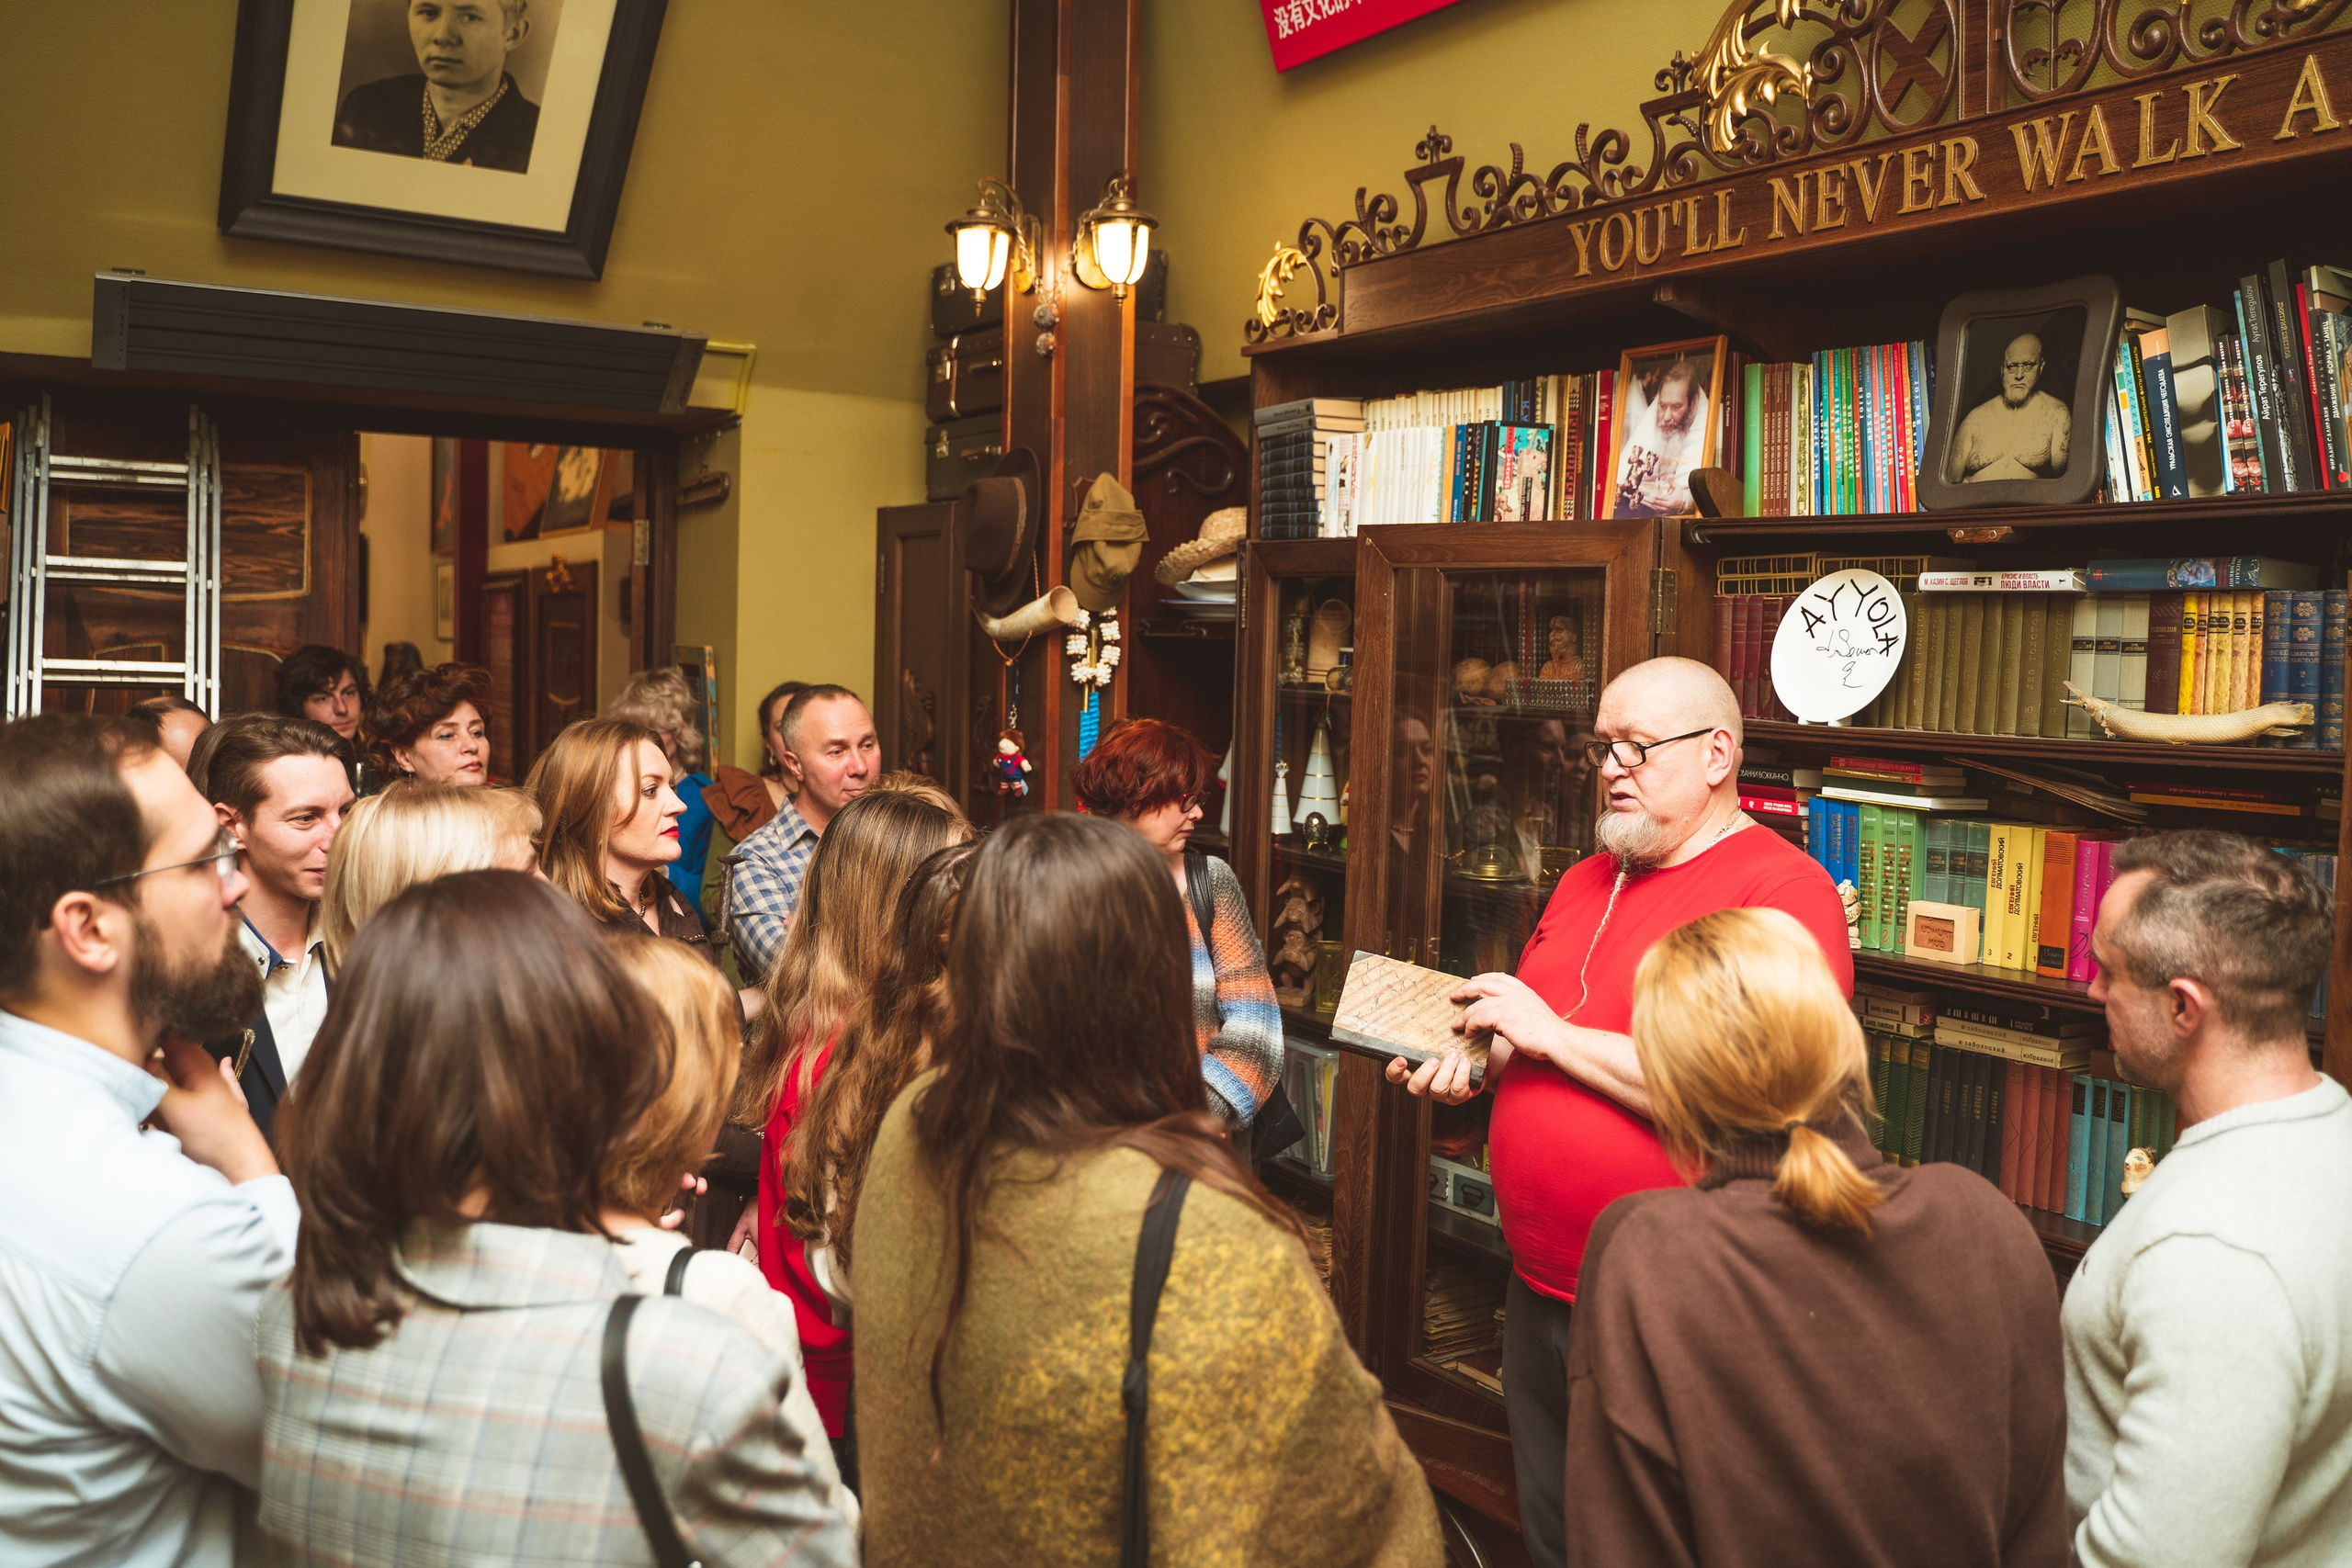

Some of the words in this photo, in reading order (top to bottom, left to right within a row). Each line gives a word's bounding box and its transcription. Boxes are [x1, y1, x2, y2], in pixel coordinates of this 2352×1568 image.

[1273, 0, 1362, 39] 没有文化
[1566, 188, 1746, 276] YOU'LL
[1767, 137, 1986, 240] NEVER
[2007, 73, 2245, 192] WALK
[2273, 54, 2352, 141] A
[2245, 285, 2258, 323] Teregulov
[2250, 322, 2261, 343] Ayrat
[2255, 355, 2267, 395] Терегулов
[2314, 333, 2327, 400] СКУЛЬПТУРА
[2325, 349, 2334, 374] ФОРМА
[2309, 366, 2317, 394] Советский
[2261, 396, 2271, 420] Айрат
[2329, 383, 2340, 419] ДВИЖЕНИЕ
[2162, 400, 2174, 437] ЭКСПЕДИЦИЯ
[2166, 438, 2177, 470] УРАЛЬСКАЯ
[2000, 580, 2021, 590] ЛЮДИ
[2023, 580, 2050, 590] ВЛАСТИ
[1916, 607, 1924, 656] ТОЛСТОЙ
[2029, 610, 2039, 661] ТОЛСТОЙ
[2027, 669, 2035, 689] ЛЕВ
[1996, 838, 2005, 890] ДОЛМАТОВСКИЙ
[2014, 863, 2024, 916] ДОЛМАТОВСКИЙ
[1862, 923, 1868, 937] 1
[1882, 929, 1889, 943] 2
[1897, 931, 1905, 944] 3
[1927, 938, 1945, 948] MUD
[2023, 1053, 2054, 1064] избранное
